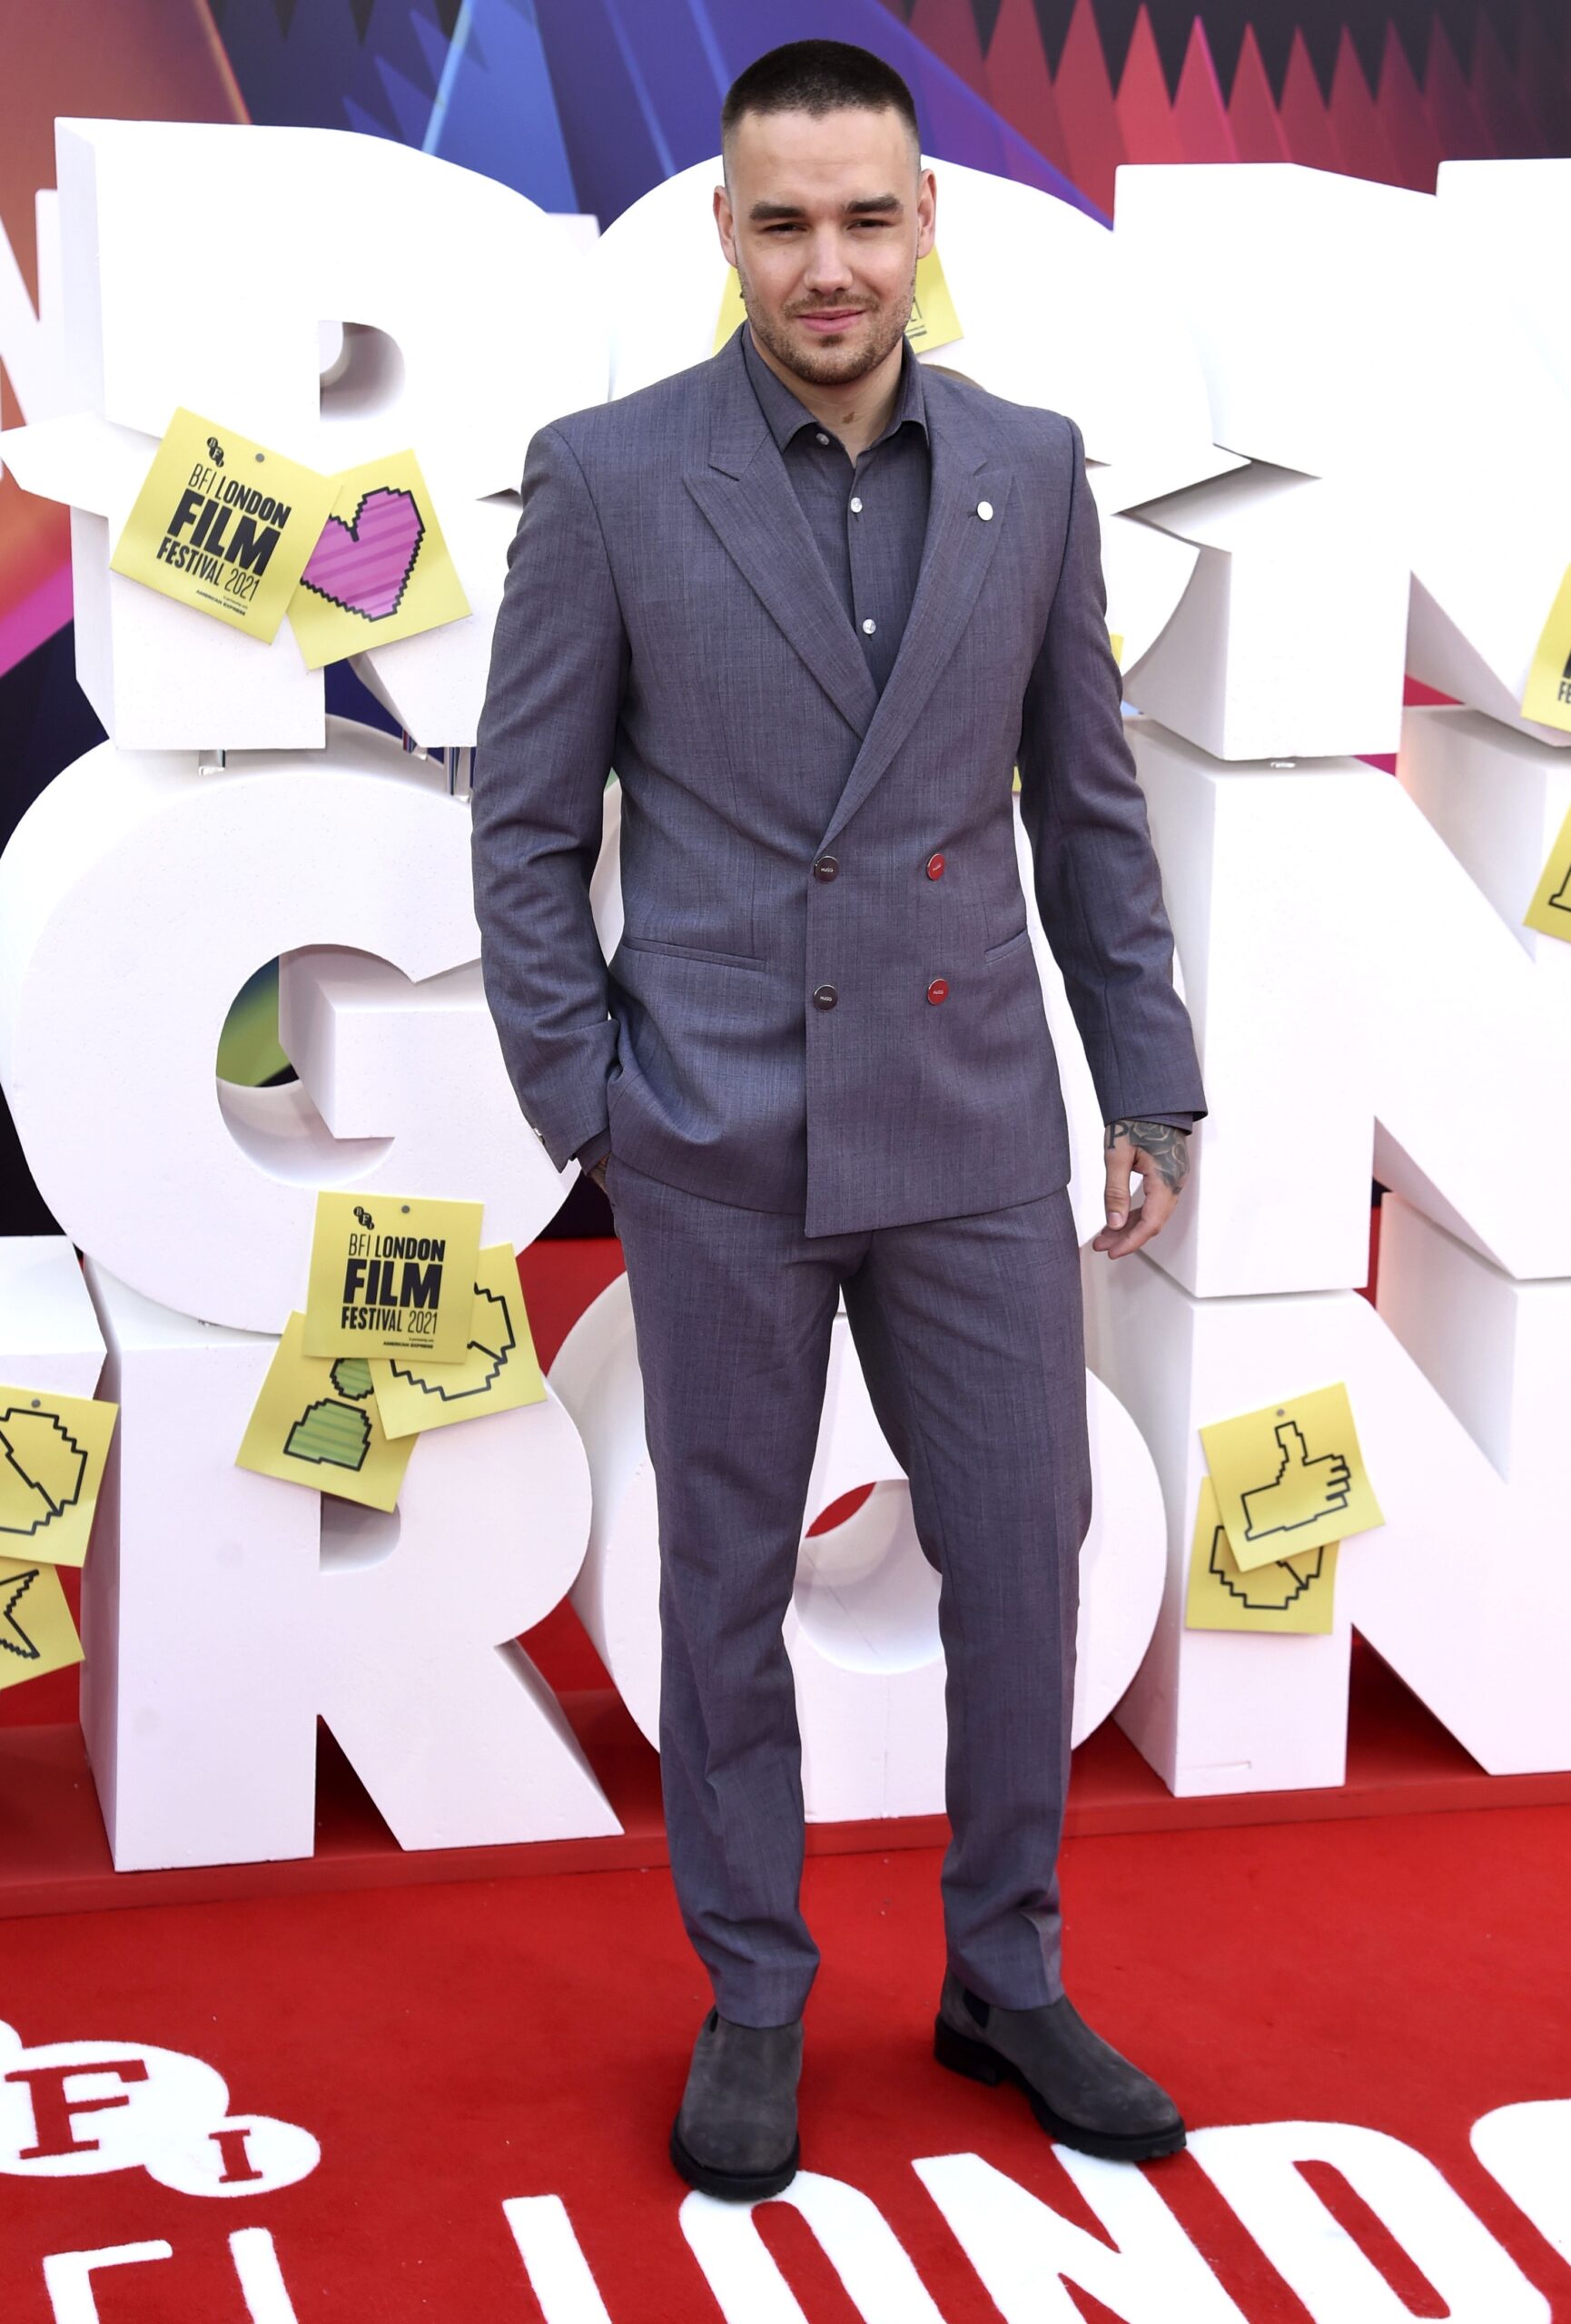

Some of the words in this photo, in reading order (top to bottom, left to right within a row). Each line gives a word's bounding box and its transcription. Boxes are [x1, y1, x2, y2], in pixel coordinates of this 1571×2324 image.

[188, 463, 217, 495] BFI
[215, 476, 292, 529] LONDON
[167, 488, 281, 576] FILM
[156, 537, 224, 586] FESTIVAL
[224, 568, 261, 602] 2021
[348, 1233, 371, 1257] BFI
[374, 1235, 446, 1262] LONDON
[343, 1258, 443, 1309] FILM
[341, 1305, 402, 1333] FESTIVAL
[407, 1310, 438, 1334] 2021
